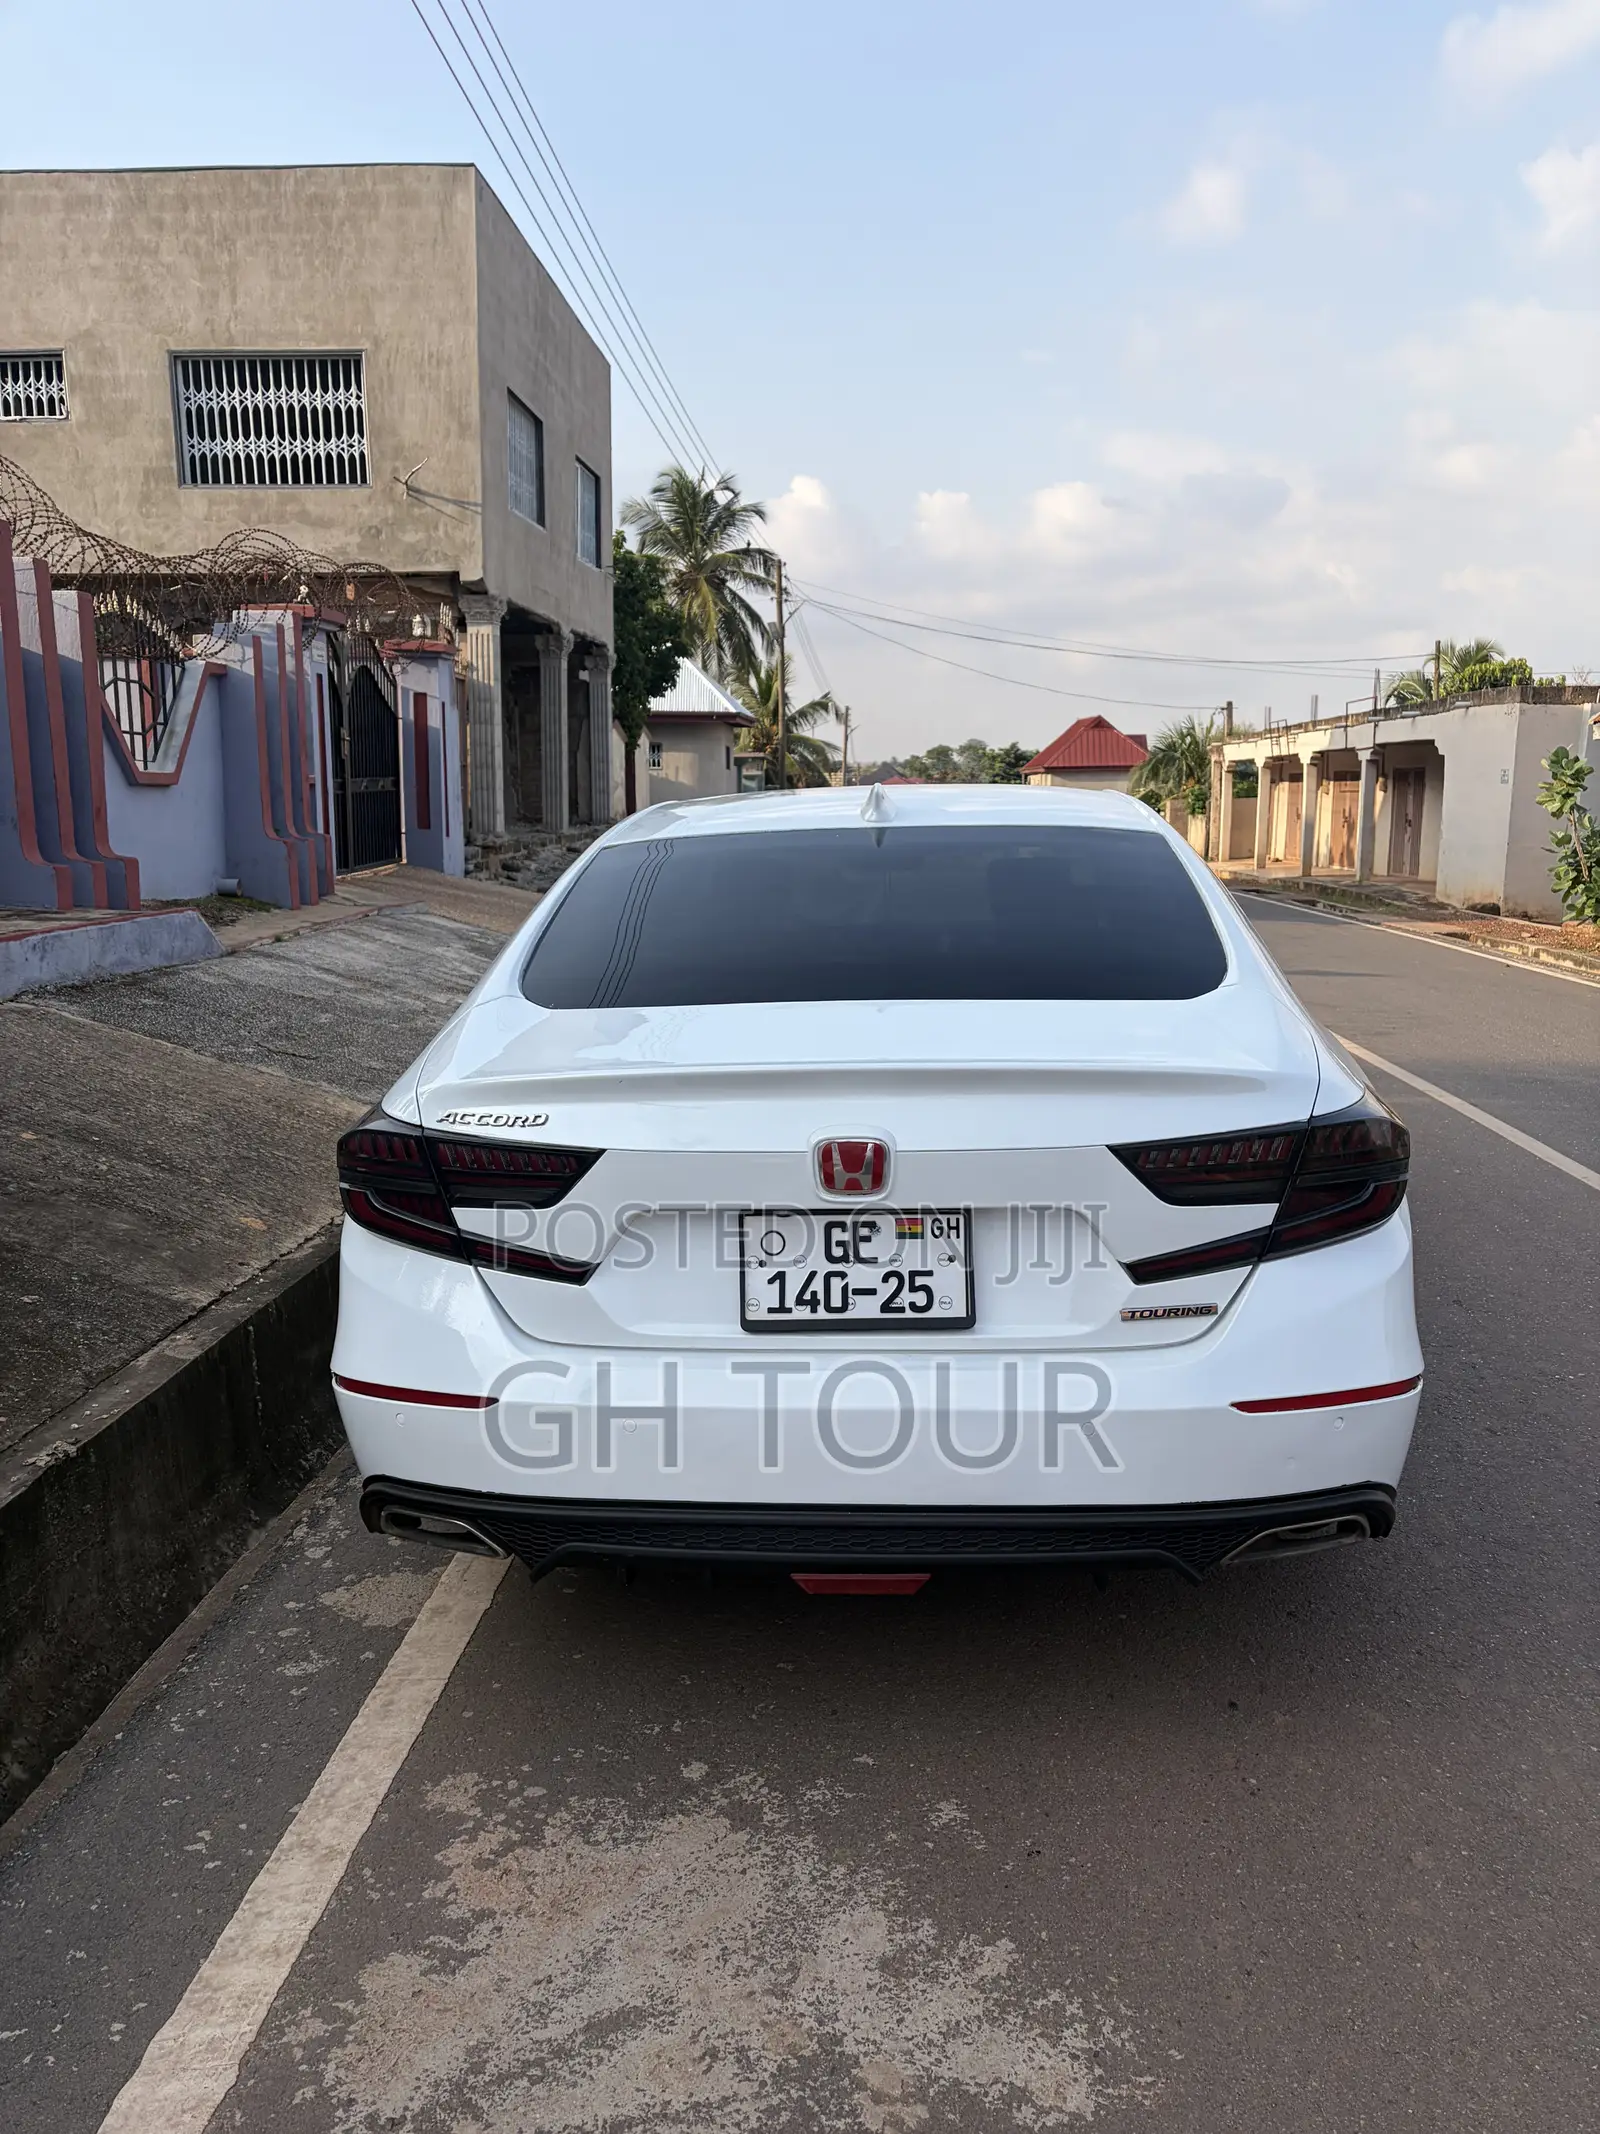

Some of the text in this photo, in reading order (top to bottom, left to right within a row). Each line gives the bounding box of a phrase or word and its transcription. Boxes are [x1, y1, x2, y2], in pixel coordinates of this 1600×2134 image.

[436, 1112, 549, 1128] ACCORD
[930, 1217, 961, 1239] GH
[824, 1221, 878, 1264] GE
[767, 1270, 934, 1314] 140-25
[1127, 1306, 1213, 1320] TOURING
